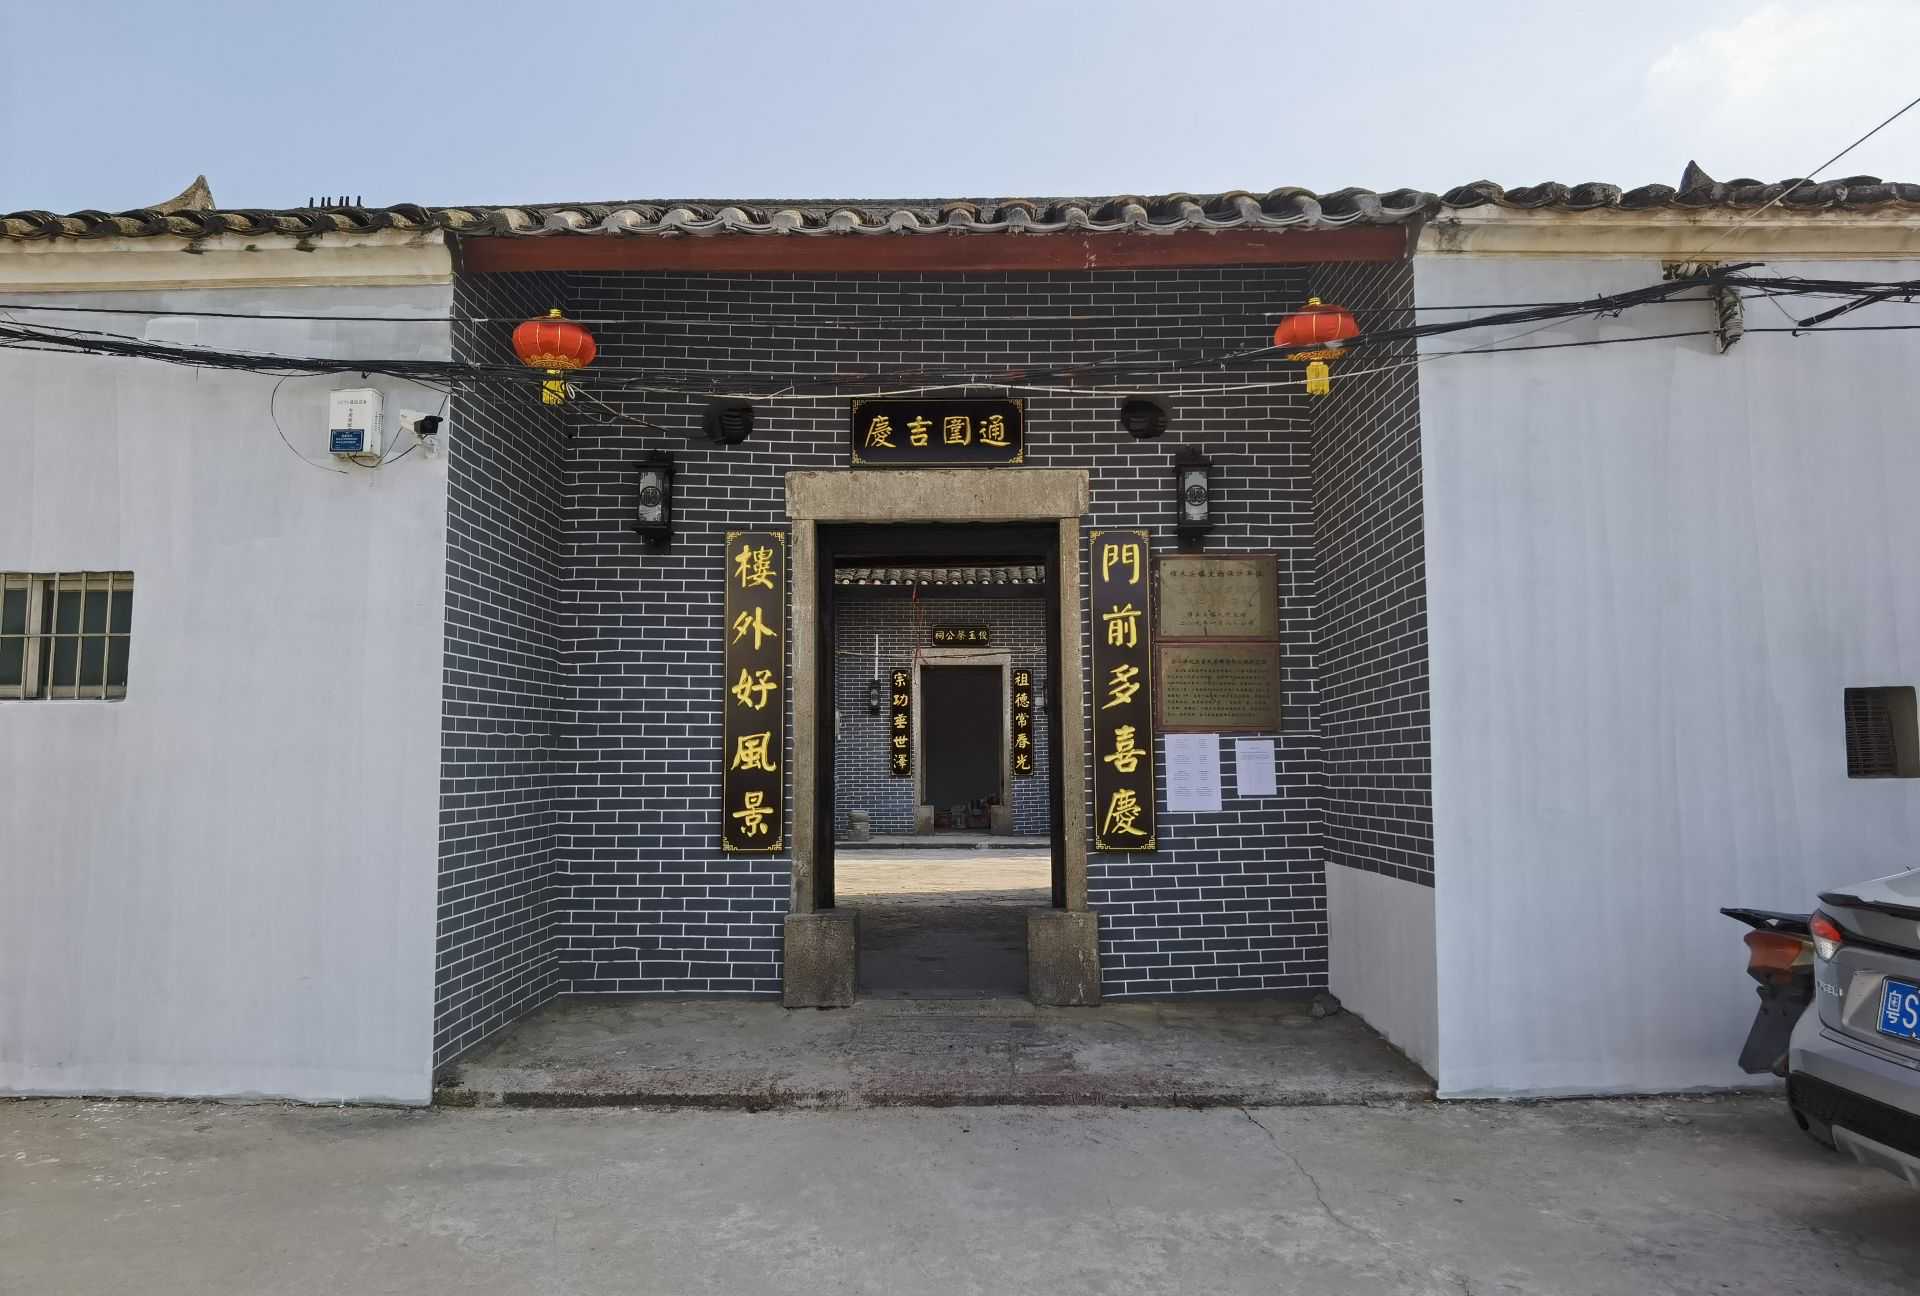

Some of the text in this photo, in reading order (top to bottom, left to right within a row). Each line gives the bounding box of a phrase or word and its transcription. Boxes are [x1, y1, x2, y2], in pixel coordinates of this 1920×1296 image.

[731, 545, 777, 838] 樓外好風景
[1101, 543, 1148, 837] 門前多喜慶
